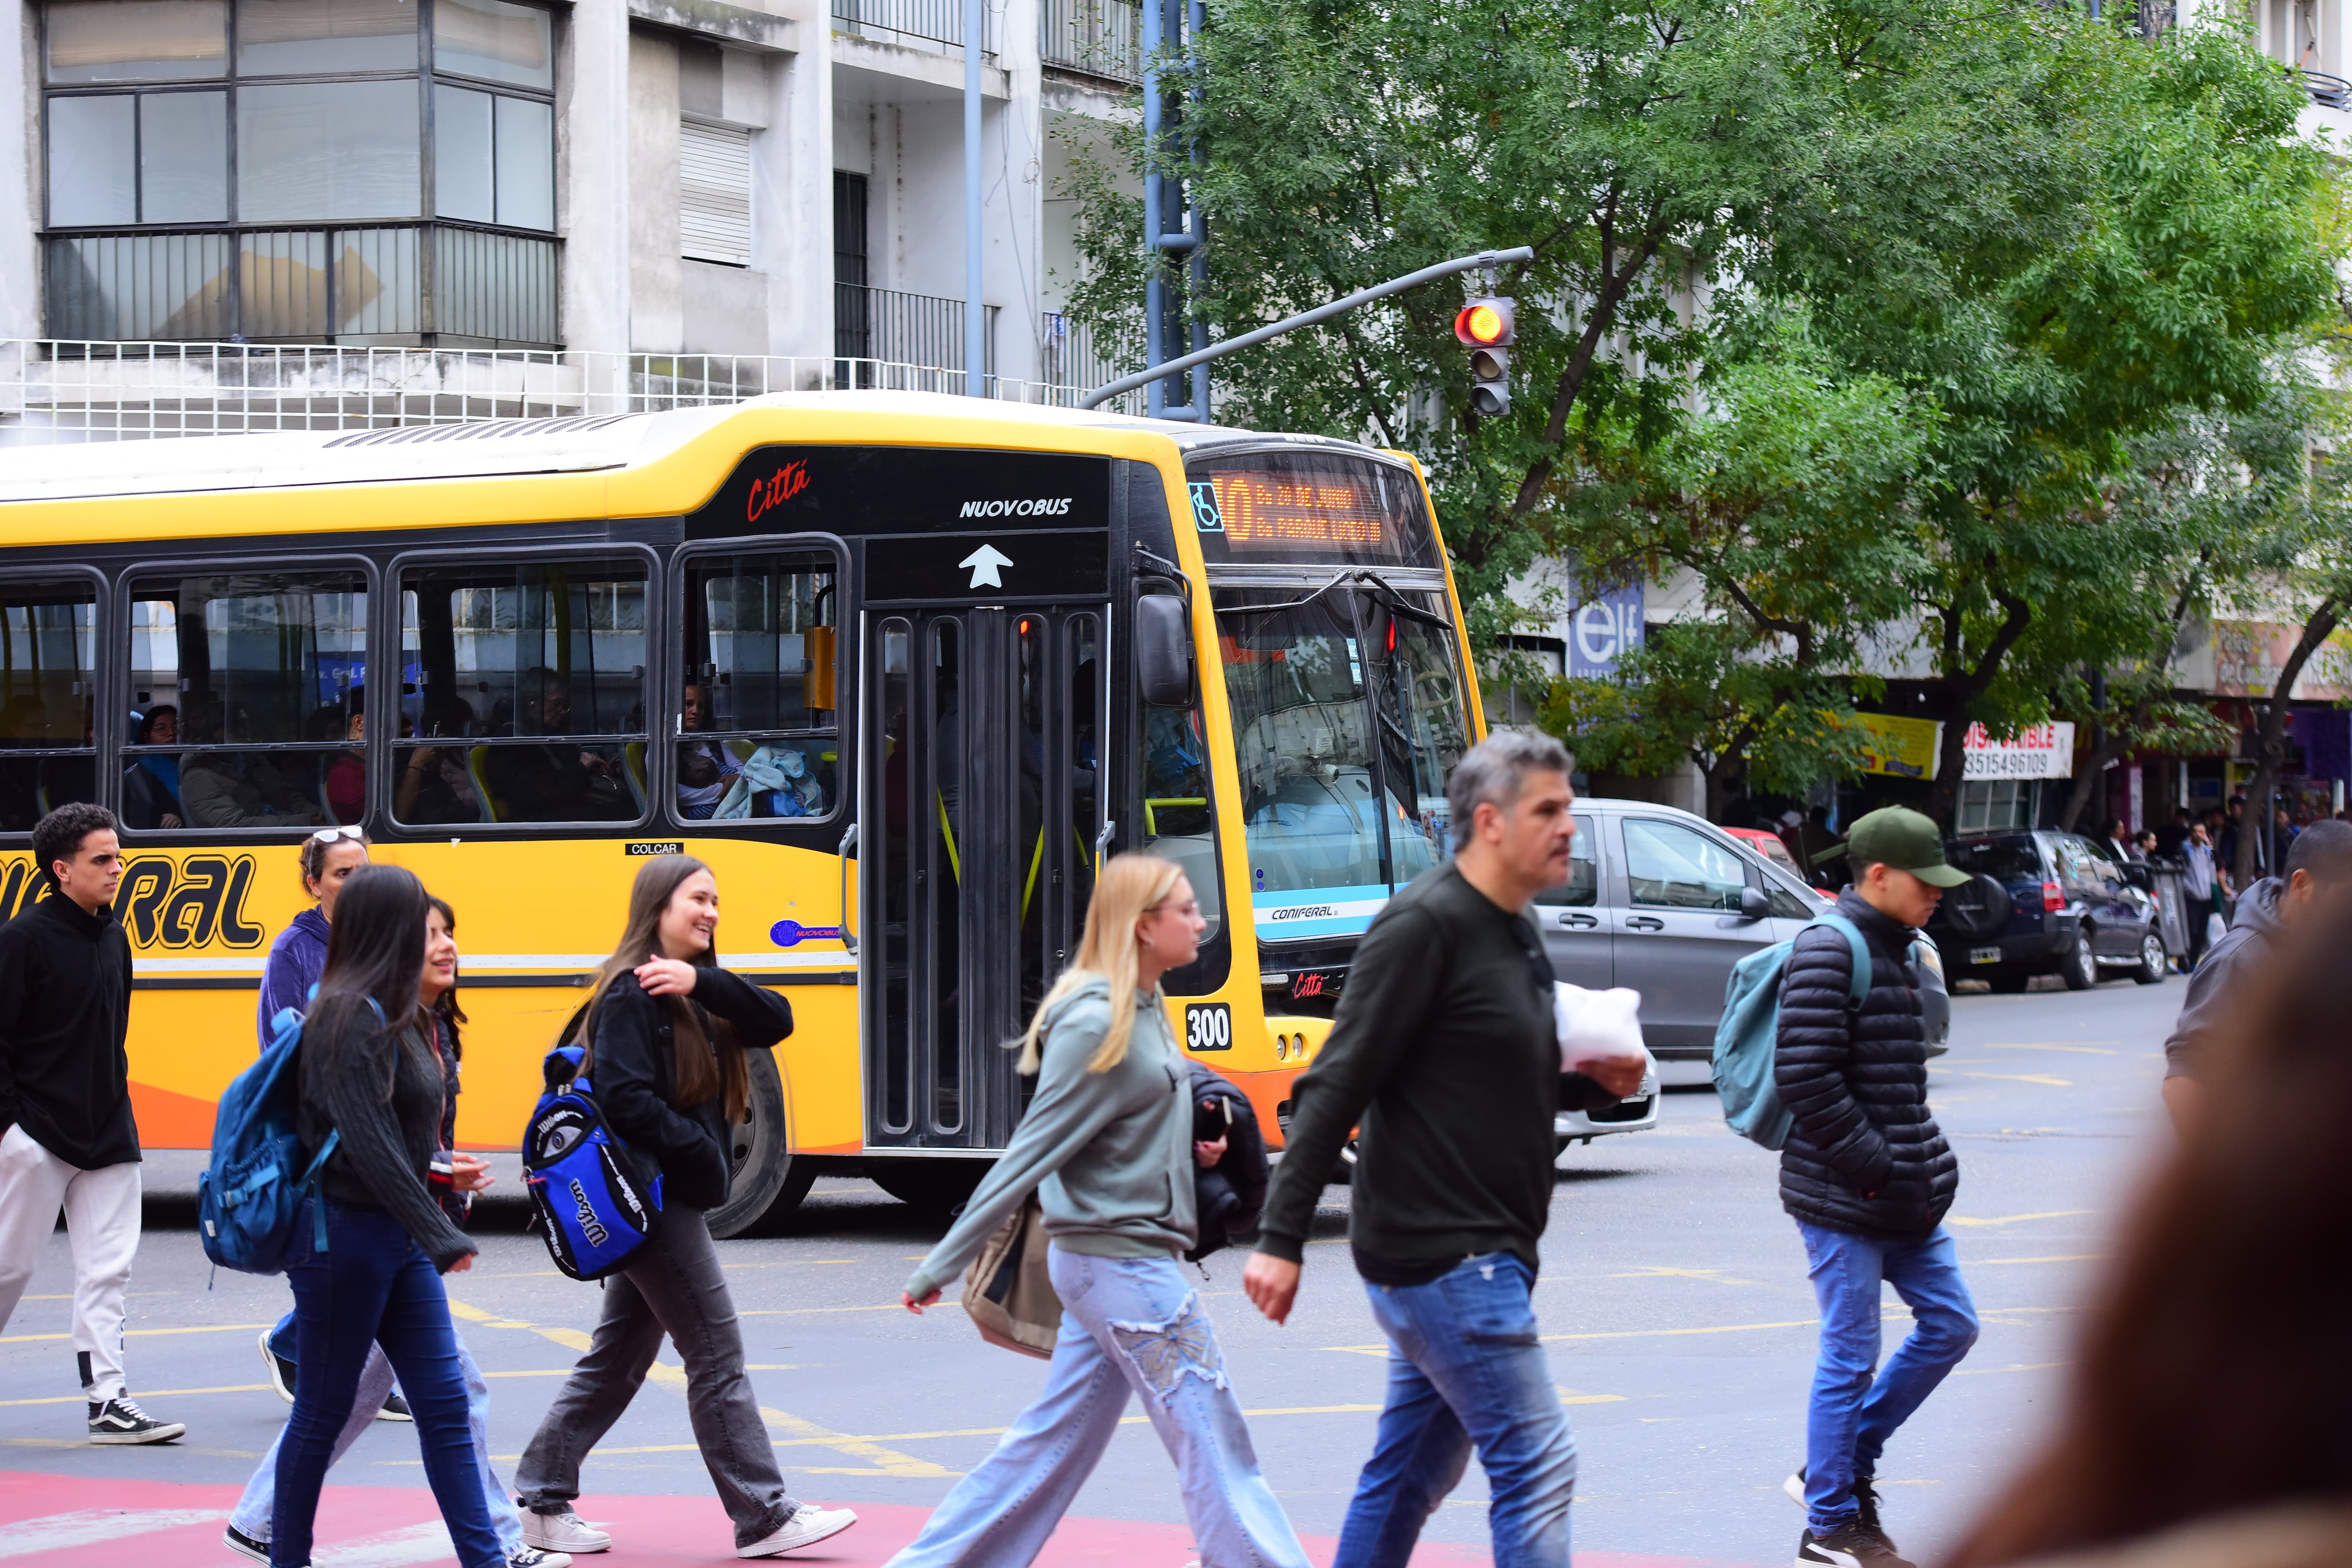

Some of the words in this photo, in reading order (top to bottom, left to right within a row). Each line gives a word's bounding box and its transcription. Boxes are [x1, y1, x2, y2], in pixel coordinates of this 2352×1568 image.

[959, 498, 1073, 518] NUOVOBUS
[1577, 600, 1638, 663] elf
[632, 844, 677, 854] COLCAR
[1272, 906, 1333, 920] CONIFERAL
[1187, 1008, 1229, 1048] 300
[569, 1178, 610, 1248] Wilson
